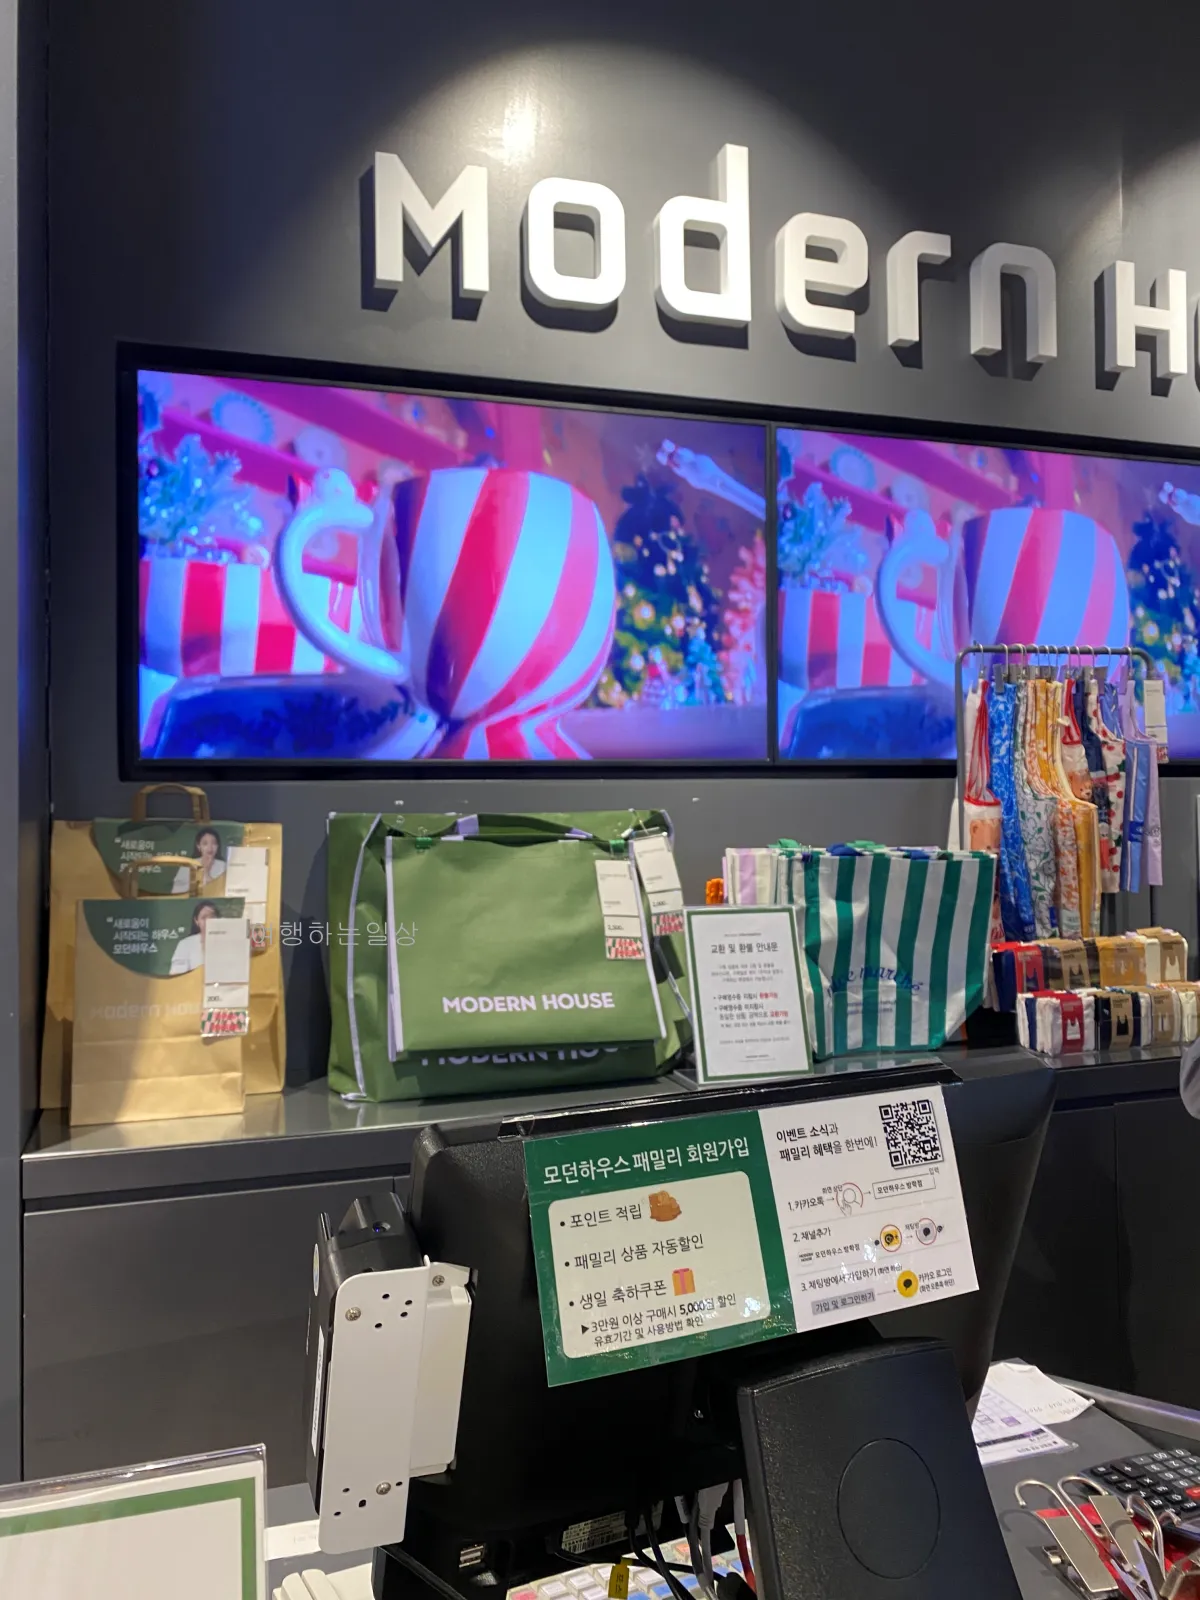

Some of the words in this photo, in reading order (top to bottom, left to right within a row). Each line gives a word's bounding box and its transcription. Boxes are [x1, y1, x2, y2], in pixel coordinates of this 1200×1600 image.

[372, 143, 1058, 364] Modern
[1103, 259, 1200, 379] H
[113, 930, 149, 941] 시작되는
[112, 943, 158, 955] 모던하우스
[711, 943, 726, 954] 교환
[728, 943, 736, 953] 및
[739, 943, 753, 953] 환불
[756, 941, 779, 953] 안내문
[442, 995, 536, 1014] MODERN
[543, 992, 615, 1012] HOUSE
[776, 1126, 807, 1143] 이벤트
[810, 1122, 839, 1138] 소식과
[779, 1145, 811, 1162] 패밀리
[812, 1140, 842, 1157] 혜택을
[845, 1135, 878, 1153] 한번에!
[543, 1155, 631, 1185] 모던하우스
[632, 1146, 683, 1172] 패밀리
[687, 1136, 750, 1164] 회원가입
[929, 1166, 940, 1176] 입력
[821, 1186, 833, 1195] 화면
[833, 1184, 843, 1193] 상단
[877, 1183, 905, 1195] 모던하우스
[570, 1208, 612, 1229] 포인트
[616, 1203, 642, 1222] 적립
[801, 1226, 832, 1242] 채널추가
[574, 1249, 616, 1270] 패밀리
[621, 1243, 648, 1262] 상품
[652, 1233, 704, 1256] 자동할인
[815, 1247, 843, 1259] 모던하우스
[847, 1267, 877, 1282] 가입하기
[918, 1272, 935, 1283] 카카오
[936, 1267, 953, 1279] 로그인
[580, 1290, 607, 1310] 생일
[612, 1279, 667, 1303] 축하쿠폰
[815, 1300, 829, 1313] 가입
[832, 1298, 840, 1309] 및
[841, 1291, 875, 1307] 로그인하기
[591, 1318, 619, 1333] 3만원
[622, 1312, 643, 1327] 이상
[646, 1304, 677, 1322] 구매시
[679, 1298, 715, 1316] 5,000원
[717, 1292, 736, 1309] 할인
[594, 1330, 632, 1347] 유효기간
[635, 1327, 644, 1340] 및
[647, 1320, 684, 1337] 사용방법
[686, 1314, 703, 1328] 확인
